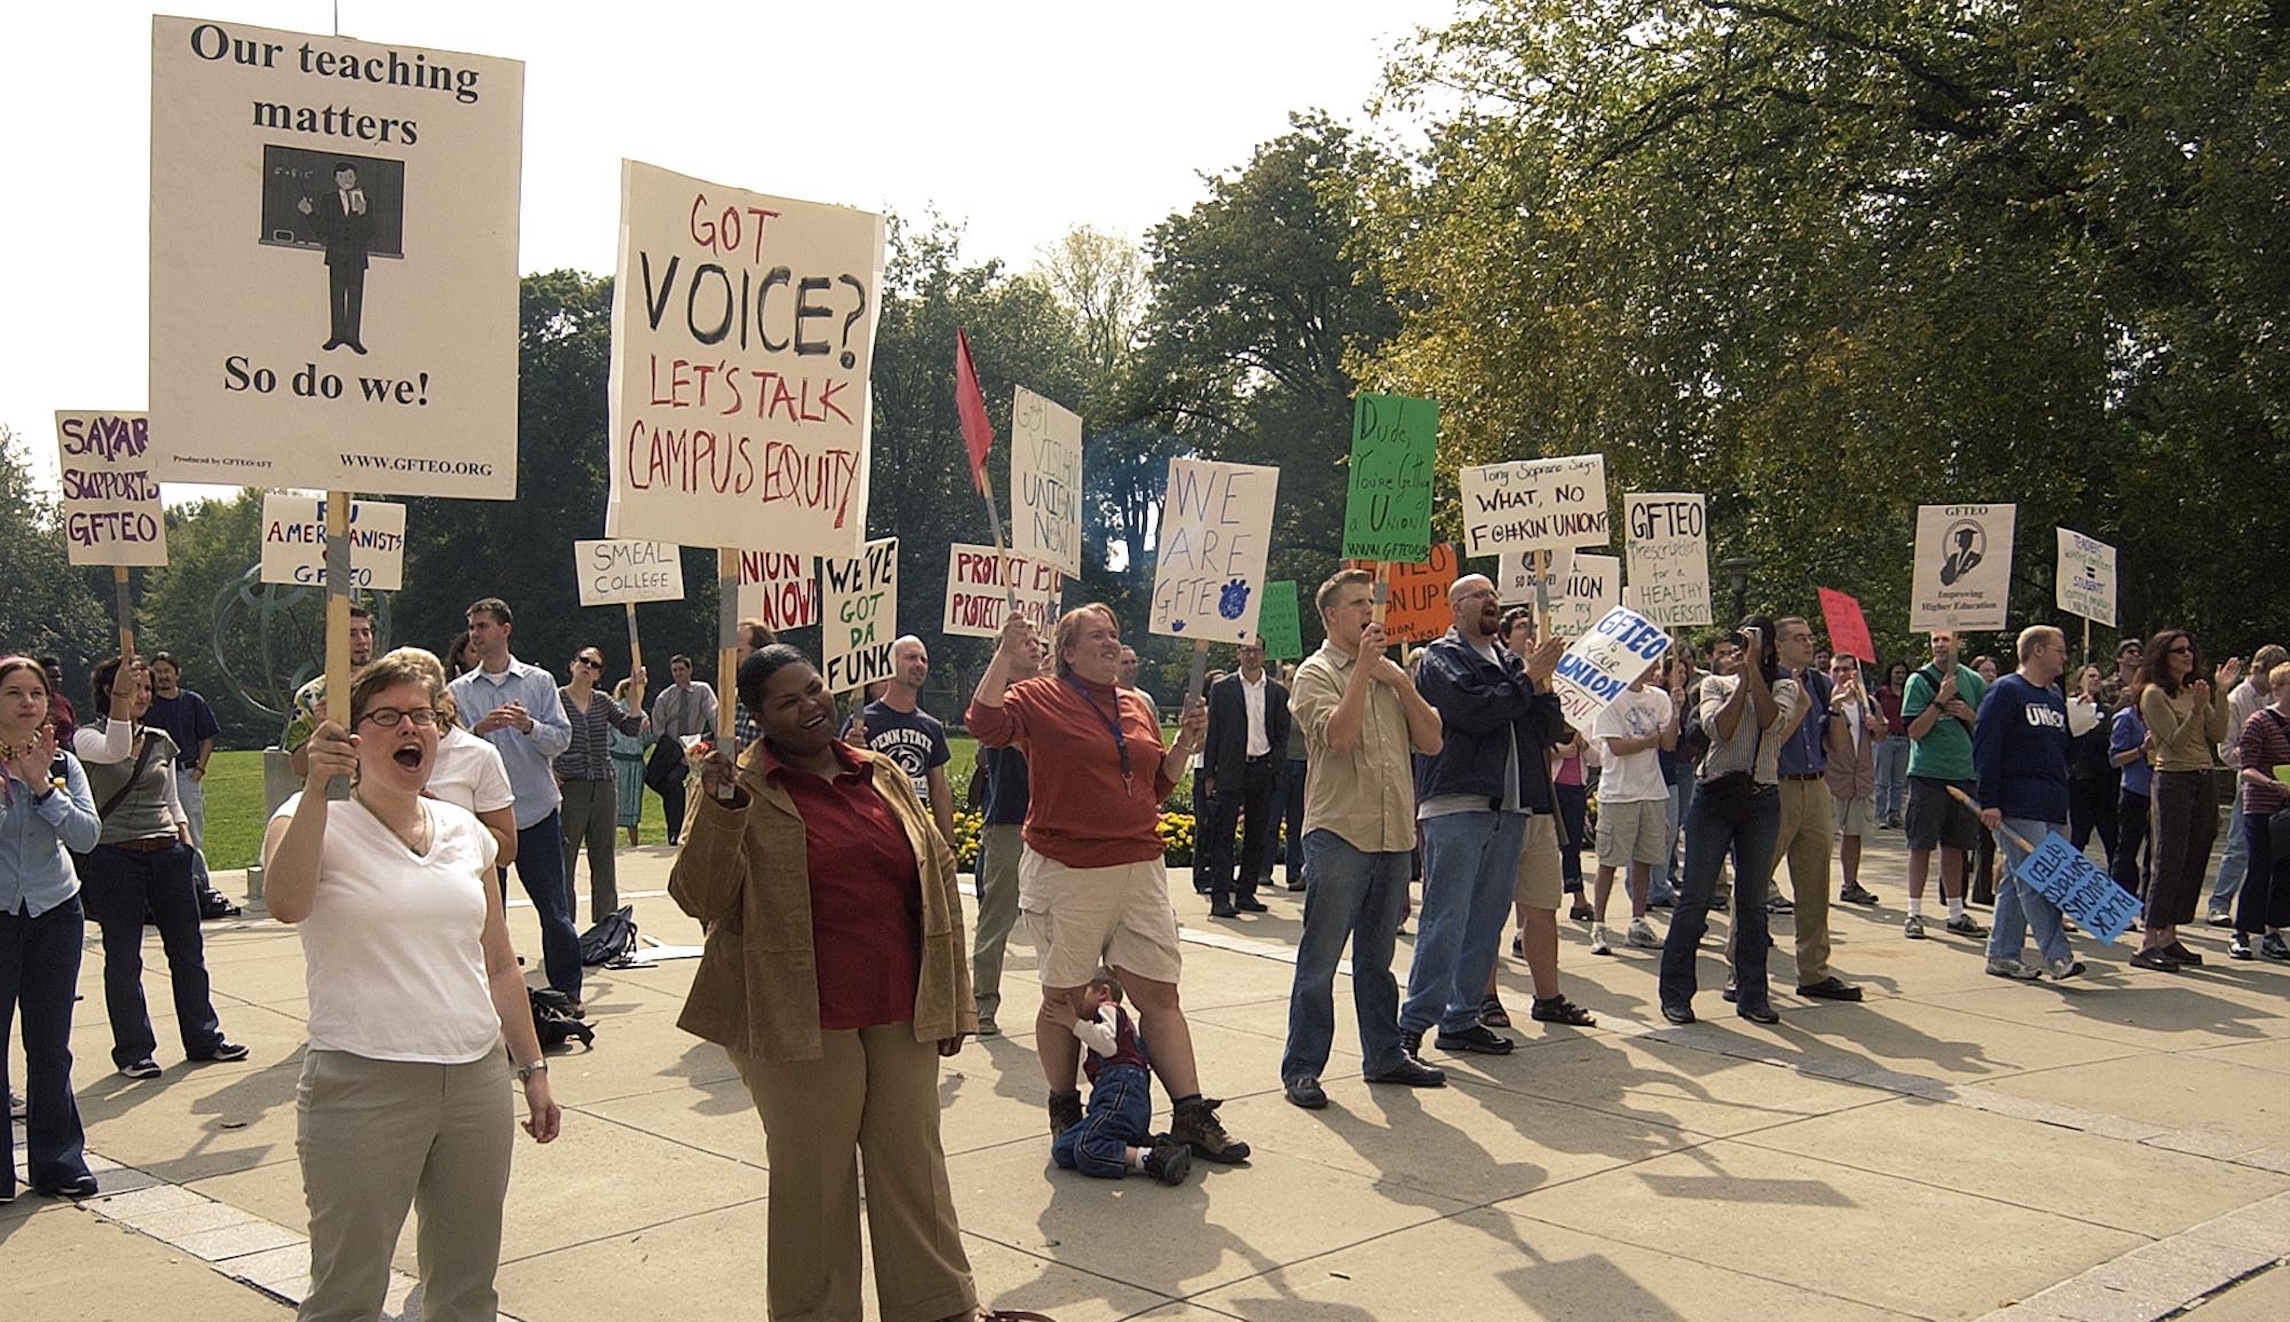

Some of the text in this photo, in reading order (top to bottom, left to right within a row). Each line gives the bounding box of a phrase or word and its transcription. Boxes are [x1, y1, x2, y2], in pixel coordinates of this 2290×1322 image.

[190, 24, 480, 104] Our teaching
[252, 100, 418, 147] matters
[691, 194, 782, 264] GOT
[640, 251, 866, 370] VOICE?
[224, 356, 429, 406] So do we!
[650, 353, 853, 426] LET'S TALK
[1360, 397, 1411, 450] Dude,
[339, 453, 493, 477] WWW.GFTEO.ORG
[629, 420, 860, 529] CAMPUS EQUITY
[1176, 466, 1254, 525] WE
[1476, 485, 1585, 513] WHAT, NO
[1945, 506, 1988, 516] GFTEO
[69, 512, 157, 546] GFTEO
[267, 521, 403, 552] AMERANISTS
[1632, 502, 1703, 540] GFTEO
[593, 542, 673, 571] SMEAL
[737, 551, 800, 586] NION
[826, 541, 896, 594] WE'VE
[1162, 527, 1252, 577] ARE
[294, 565, 372, 588] GFEO
[594, 571, 668, 593] COLLEGE
[1641, 582, 1704, 604] HEALTHY
[1938, 589, 1984, 600] Improving
[839, 592, 885, 624] GOT
[951, 593, 1006, 630] PROTECT
[1634, 604, 1708, 623] NIVERSITY
[1921, 601, 1997, 612] Higher Education
[850, 622, 875, 650] DA
[1597, 610, 1668, 660] GFTEO
[827, 642, 895, 690] FUNK
[1556, 653, 1627, 702] UNION
[870, 727, 934, 752] PENN STATE
[2028, 843, 2069, 883] GFTEO
[2043, 854, 2094, 904] SUPPORTS
[2061, 871, 2112, 922] CAUCUS
[2088, 889, 2135, 937] BLACK
